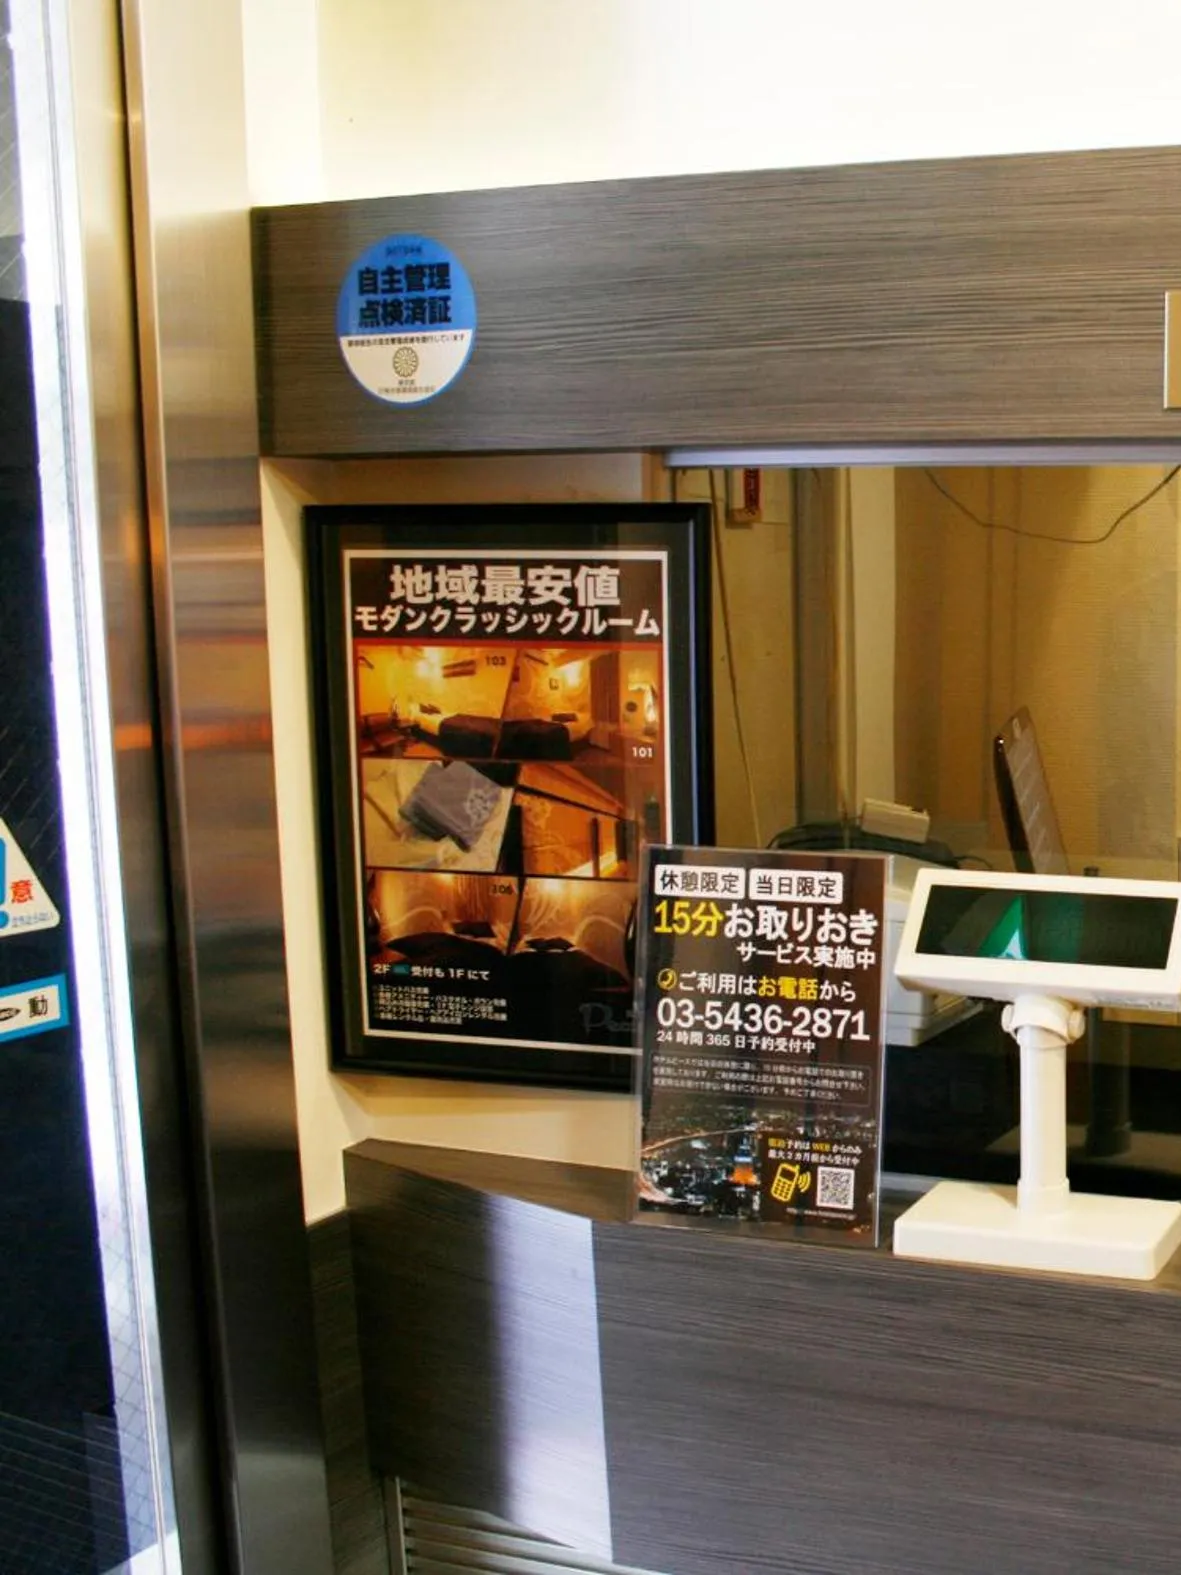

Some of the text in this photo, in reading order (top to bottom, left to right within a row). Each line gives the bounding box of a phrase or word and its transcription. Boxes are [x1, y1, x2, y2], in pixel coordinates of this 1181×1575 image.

[358, 261, 451, 296] 自主管理
[389, 564, 621, 606] 地域最安値
[354, 604, 661, 636] モダンクラッシックルーム
[485, 655, 507, 667] 103
[631, 746, 653, 759] 101
[660, 869, 838, 898] 休憩限定 当日限定
[653, 899, 879, 946] 15分お取りおき
[736, 941, 877, 970] サービス実施中
[373, 963, 391, 975] 2F
[467, 969, 490, 981] にて
[678, 970, 857, 1003] ご利用はお電話から
[656, 996, 872, 1042] 03-5436-2871
